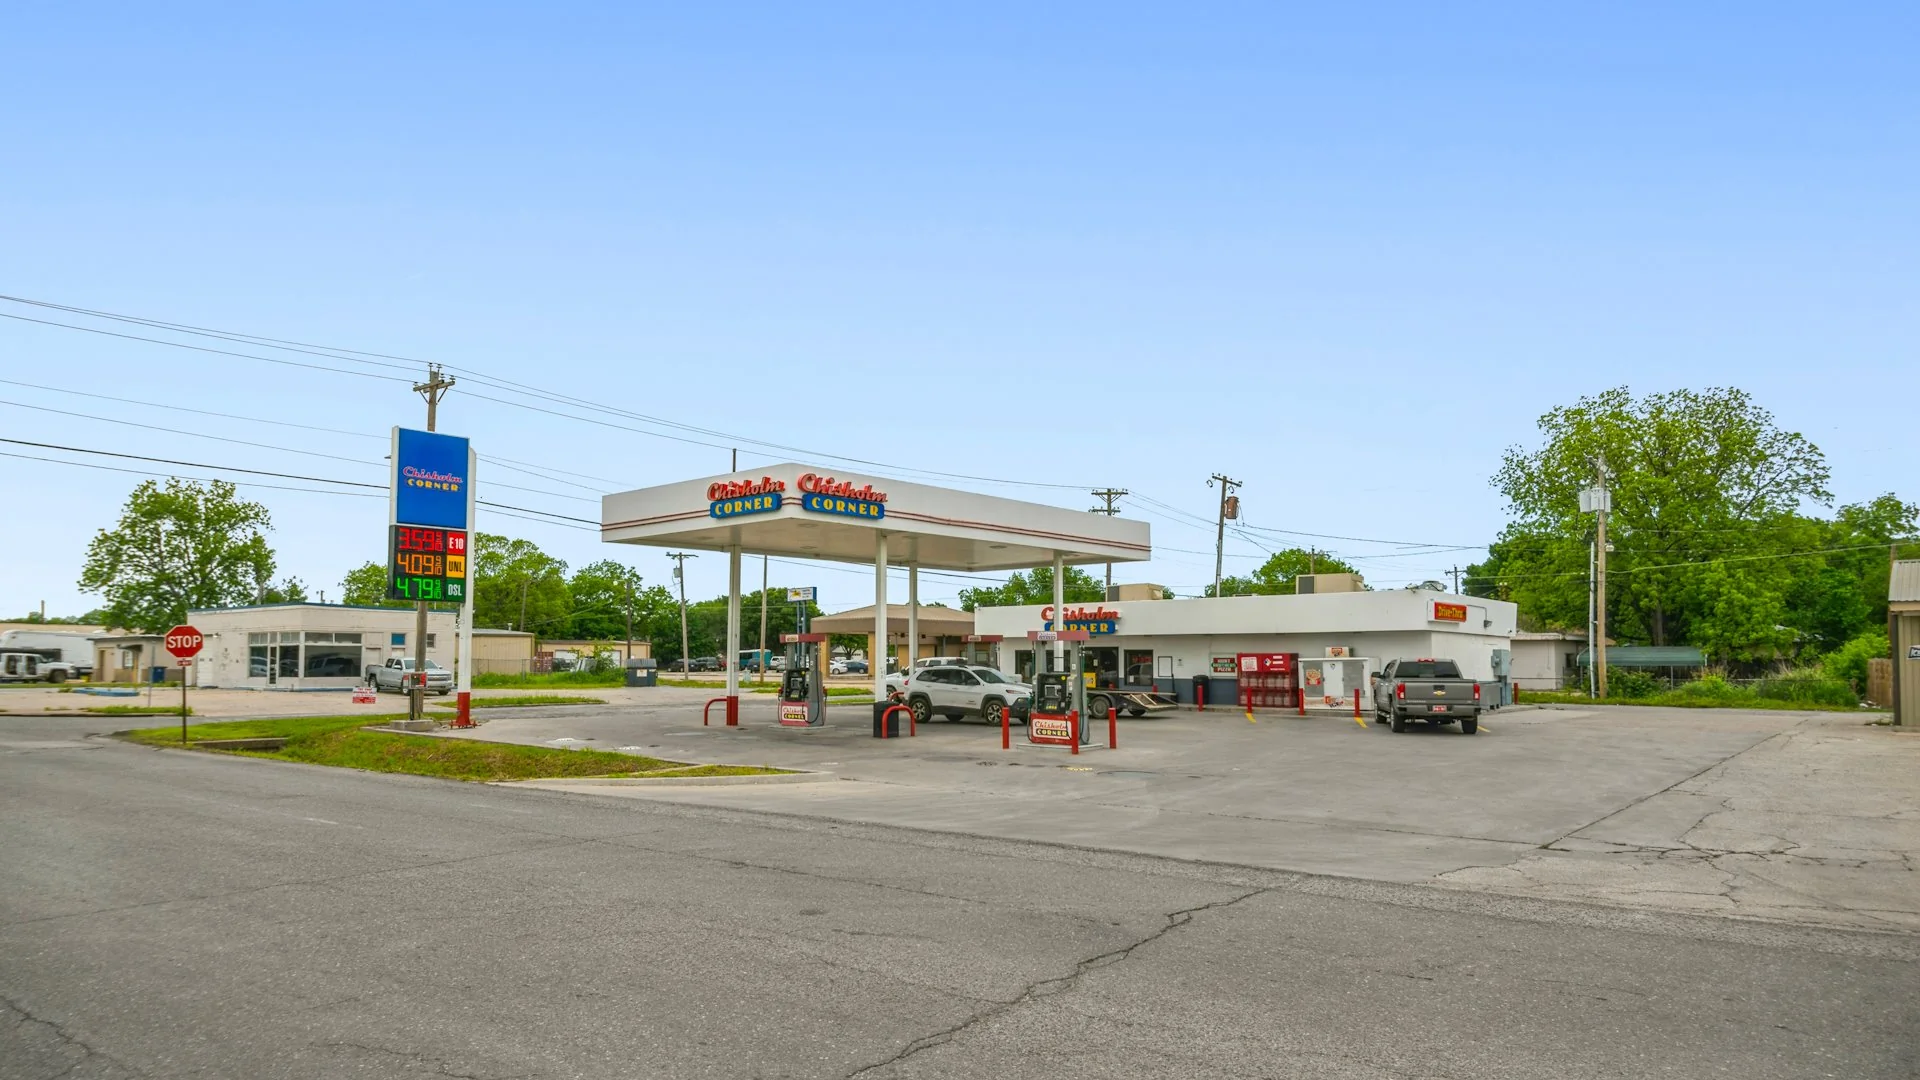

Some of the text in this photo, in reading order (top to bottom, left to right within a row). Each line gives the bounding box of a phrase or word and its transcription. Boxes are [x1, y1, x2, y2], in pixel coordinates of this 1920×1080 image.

[402, 465, 463, 484] Chisholm
[408, 478, 460, 491] CORNER
[707, 476, 785, 502] Chisholm
[797, 472, 888, 503] Chisholm
[714, 496, 773, 516] CORNER
[811, 496, 879, 517] CORNER
[398, 527, 435, 551] 3.59
[397, 552, 435, 576] 4.09
[448, 560, 463, 573] UNL
[396, 576, 434, 599] 4.79
[447, 583, 462, 596] DSL
[1041, 606, 1120, 621] Cisholm
[167, 635, 202, 649] STOP
[1037, 729, 1068, 737] CORNER
